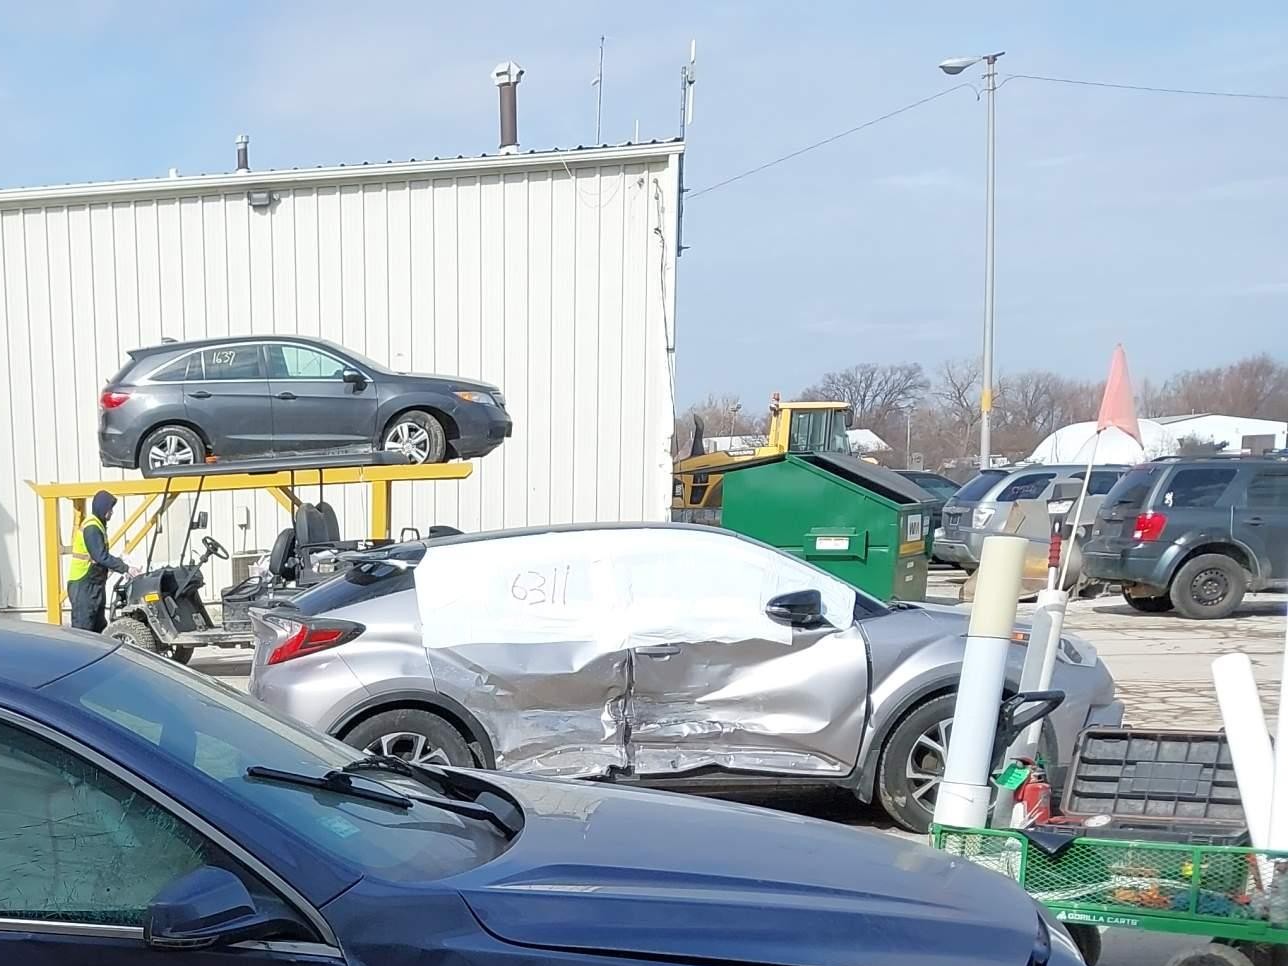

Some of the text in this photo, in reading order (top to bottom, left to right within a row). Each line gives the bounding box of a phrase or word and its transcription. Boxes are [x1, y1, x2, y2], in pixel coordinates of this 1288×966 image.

[511, 564, 571, 606] 6311
[1067, 912, 1138, 926] GORILLA CARTS
